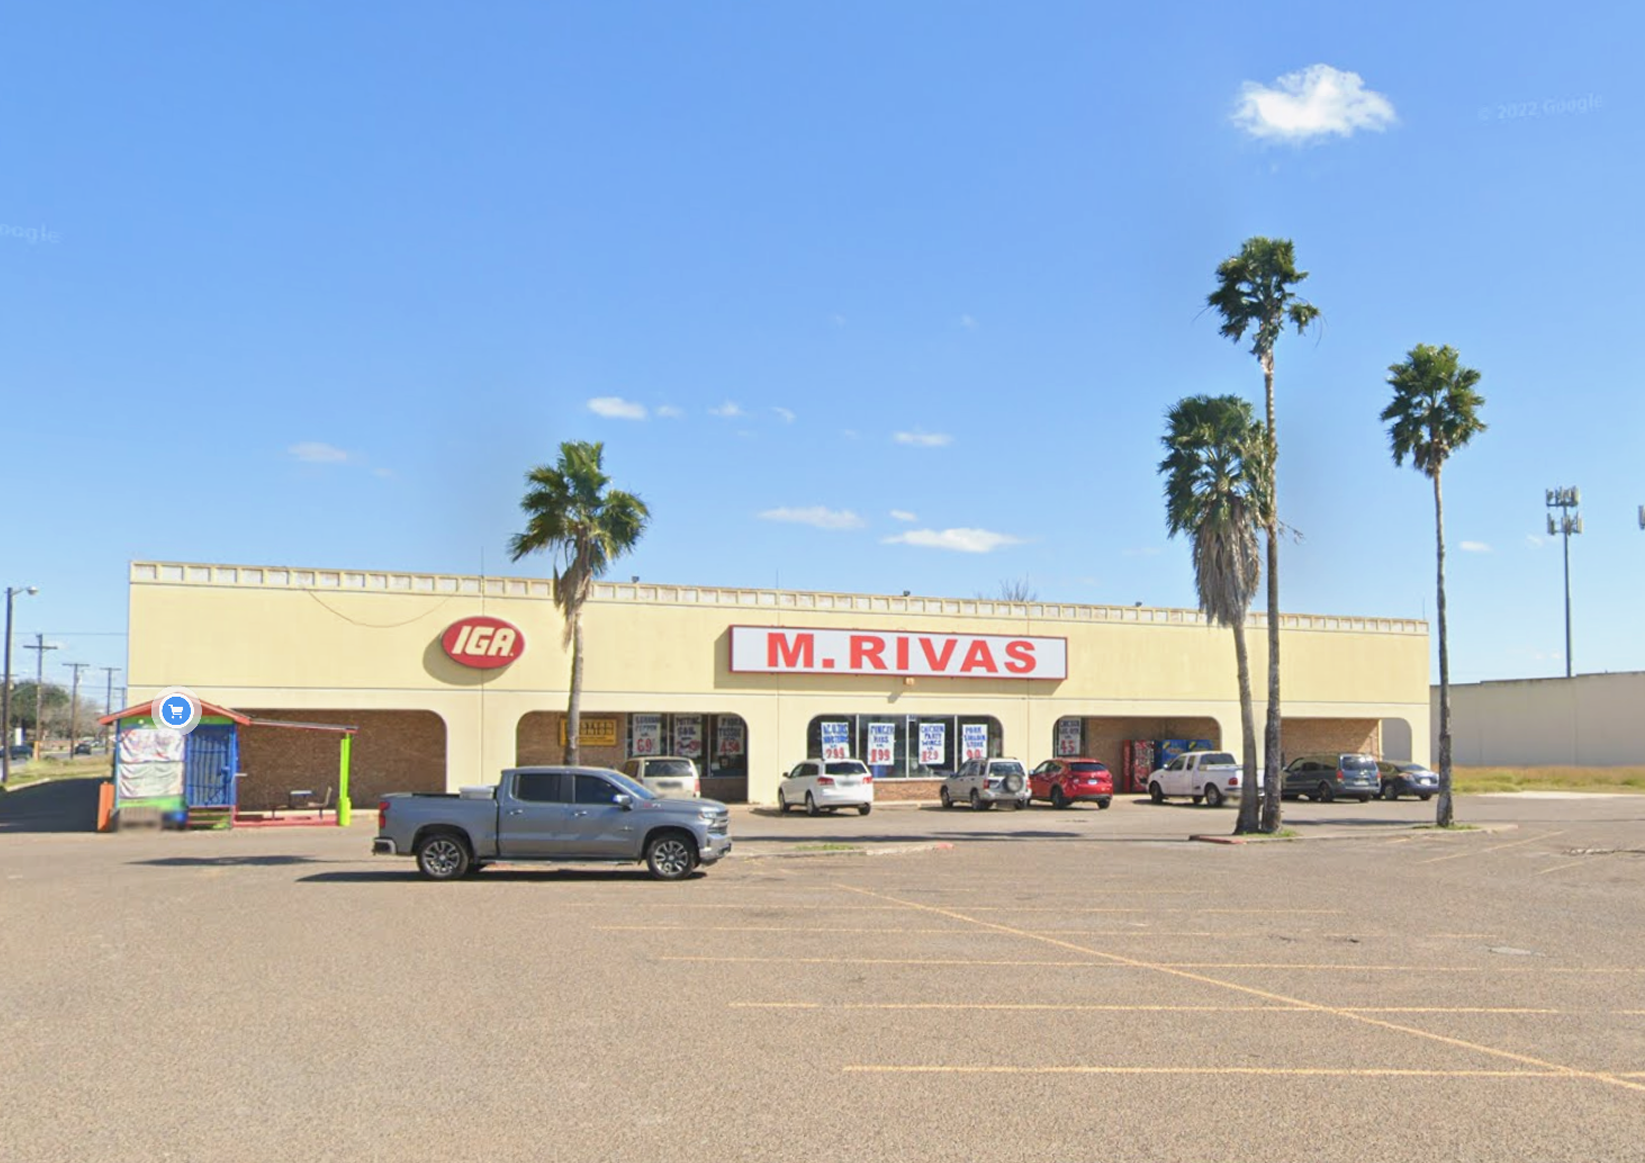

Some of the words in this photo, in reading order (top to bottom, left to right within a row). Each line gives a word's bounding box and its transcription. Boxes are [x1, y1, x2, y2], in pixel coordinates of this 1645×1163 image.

[451, 625, 516, 657] IGA
[766, 632, 835, 669] M.
[849, 635, 1037, 674] RIVAS
